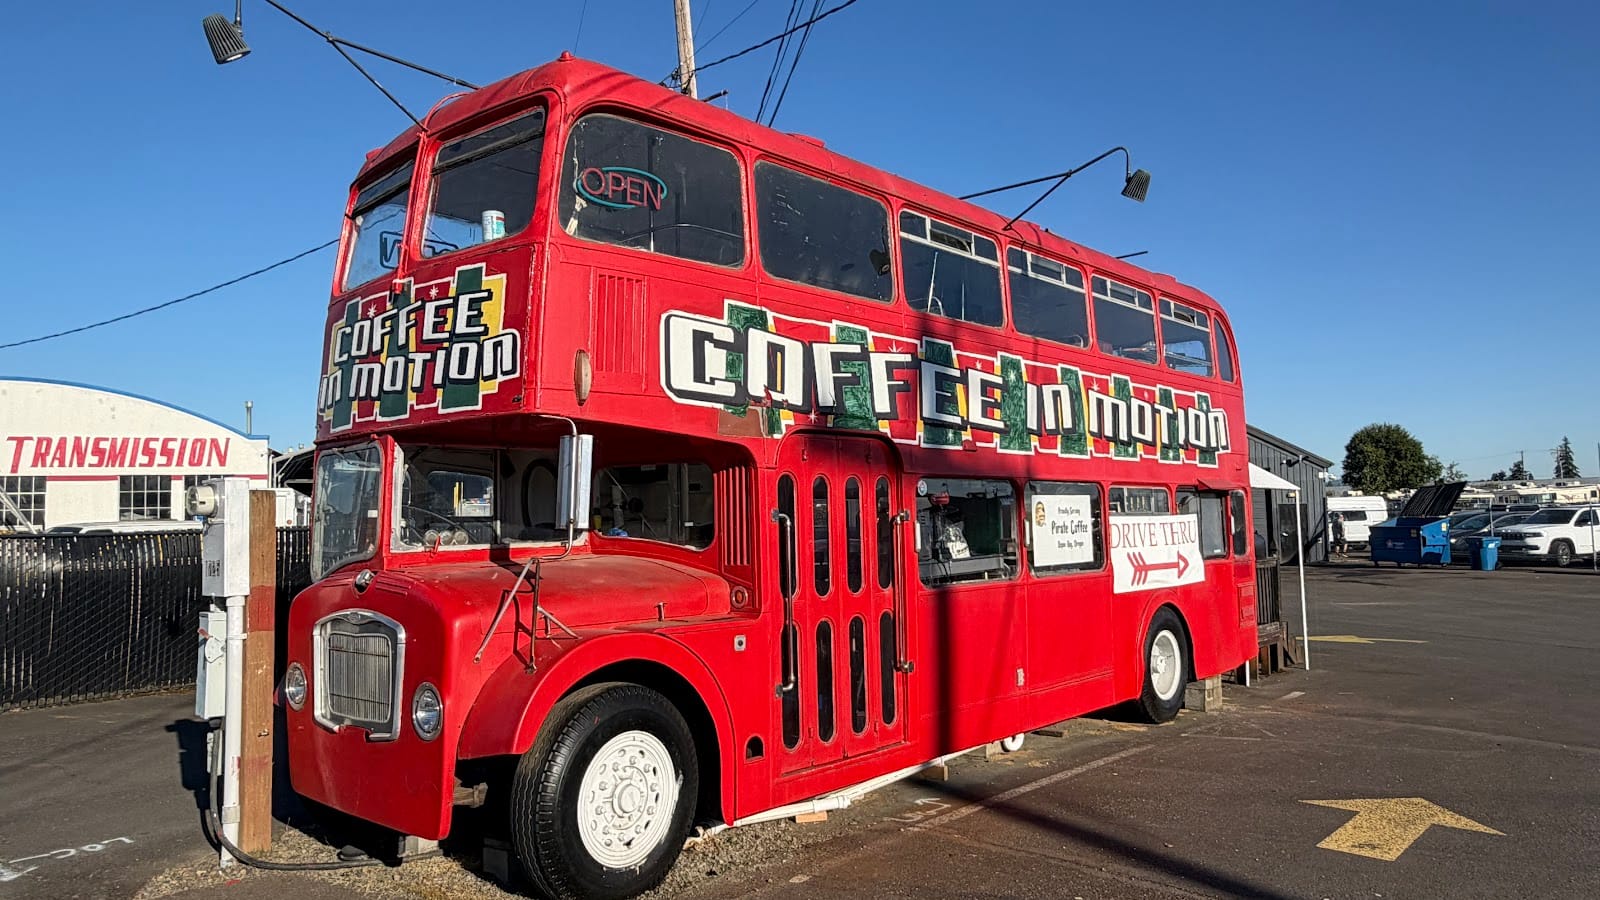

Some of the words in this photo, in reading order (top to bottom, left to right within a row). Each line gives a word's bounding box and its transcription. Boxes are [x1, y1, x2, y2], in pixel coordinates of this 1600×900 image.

[582, 167, 662, 210] OPEN
[335, 290, 493, 368] COFFEE
[667, 314, 1007, 431] COFFEE
[6, 436, 230, 473] TRANSMISSION
[1070, 519, 1088, 535] Coffee
[1111, 523, 1158, 548] DRIVE
[1160, 520, 1197, 546] THRU
